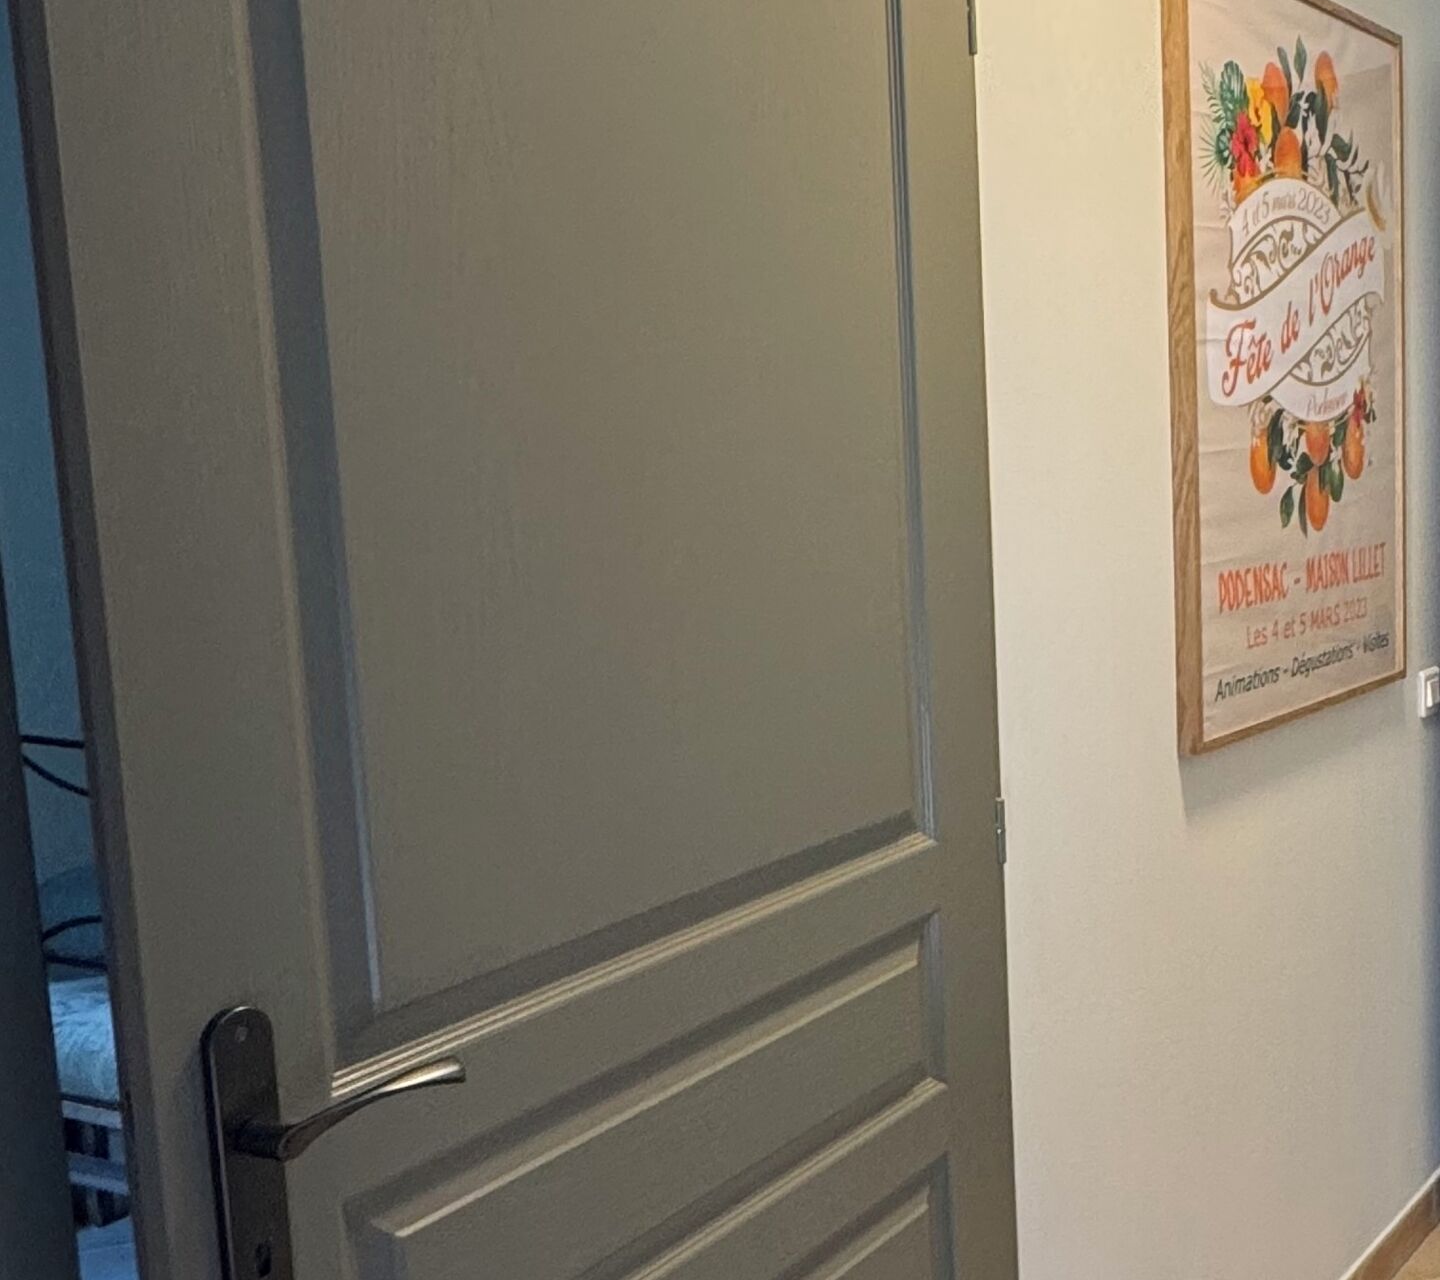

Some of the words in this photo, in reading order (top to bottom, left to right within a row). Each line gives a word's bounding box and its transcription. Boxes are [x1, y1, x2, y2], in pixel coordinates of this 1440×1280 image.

[1221, 319, 1273, 397] Fête
[1281, 300, 1299, 354] de
[1308, 235, 1376, 326] l'Orange
[1218, 562, 1290, 615] PODENSAC
[1306, 551, 1349, 592] MAISON
[1246, 625, 1268, 650] Les
[1272, 619, 1279, 641] 4
[1284, 620, 1296, 640] et
[1300, 613, 1307, 636] 5
[1310, 604, 1340, 631] MARS
[1344, 597, 1368, 622] 2023
[1215, 666, 1281, 703] Animations
